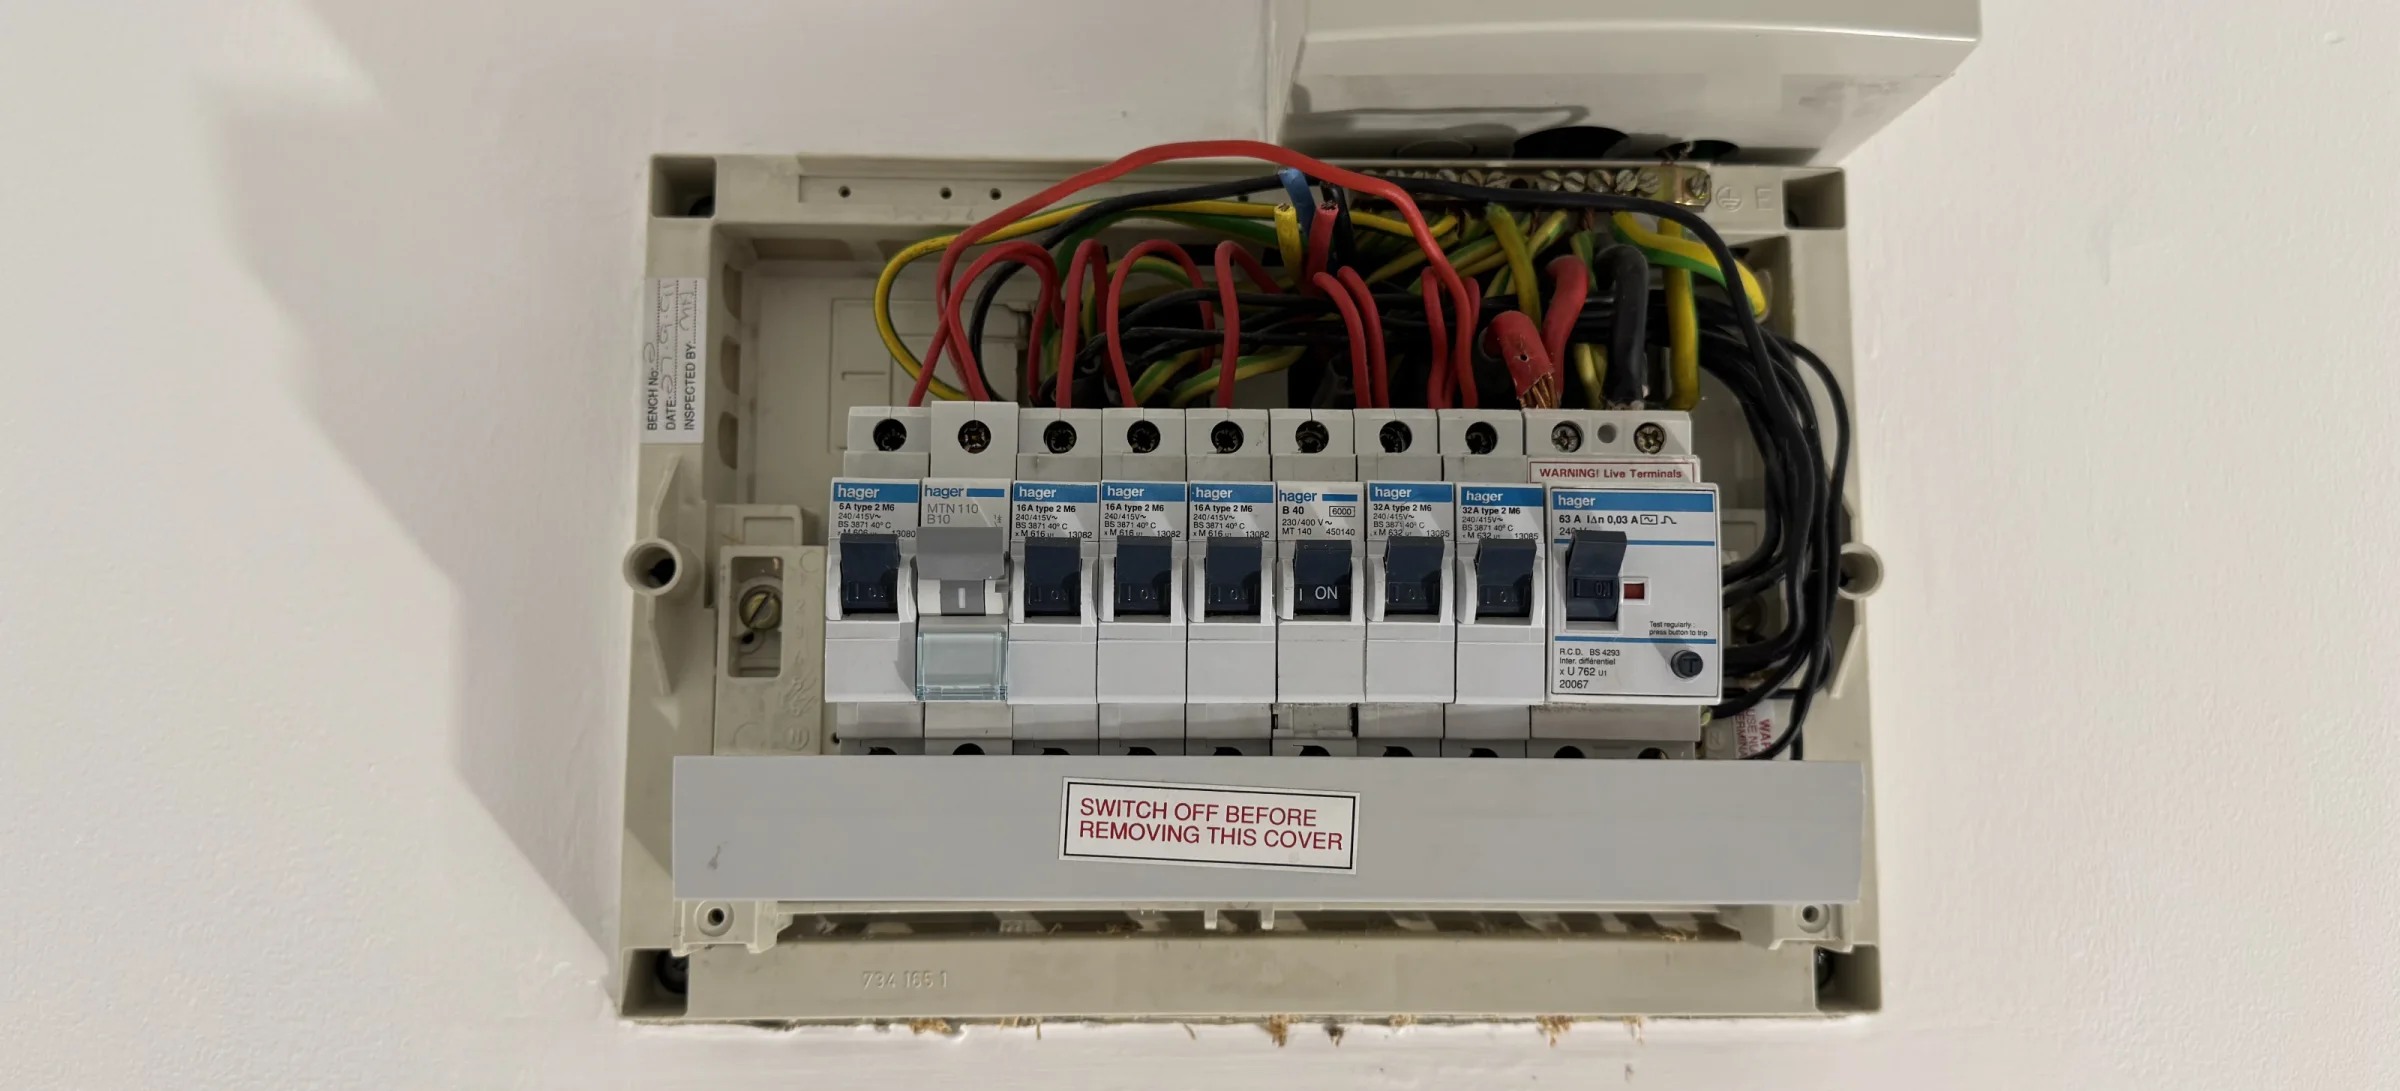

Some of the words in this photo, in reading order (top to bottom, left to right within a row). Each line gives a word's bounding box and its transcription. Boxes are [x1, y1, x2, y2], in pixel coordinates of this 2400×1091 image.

[1755, 186, 1773, 211] E
[684, 362, 696, 430] INSPECTED
[647, 391, 659, 430] BENCH
[1540, 468, 1599, 478] WARNING!
[1604, 469, 1626, 479] Live
[1630, 469, 1682, 479] Terminals
[838, 484, 880, 500] hager
[924, 484, 964, 499] hager
[1020, 486, 1057, 500] hager
[1107, 485, 1145, 500] hager
[1196, 487, 1233, 500] hager
[1375, 486, 1412, 500] hager
[1279, 490, 1317, 504] hager
[1466, 490, 1504, 504] hager
[1558, 495, 1596, 508] hager
[854, 504, 872, 512] type
[927, 504, 955, 514] MTN
[958, 504, 979, 514] 110
[1036, 505, 1054, 514] type
[1063, 505, 1076, 513] M6
[1124, 504, 1143, 512] type
[1152, 504, 1164, 512] M6
[1213, 505, 1231, 513] type
[1282, 506, 1289, 514] B
[1293, 506, 1304, 515] 40
[1392, 504, 1410, 512] type
[1420, 504, 1432, 512] M6
[1481, 507, 1499, 515] type
[1508, 507, 1521, 515] M6
[927, 514, 951, 524] B10
[1559, 515, 1571, 524] 63
[1574, 515, 1581, 524] A
[1631, 516, 1638, 524] A
[1016, 521, 1027, 529] BS
[1193, 521, 1204, 529] BS
[1326, 528, 1355, 536] 450140
[1315, 586, 1338, 600] ON
[1589, 648, 1601, 656] BS
[1602, 649, 1620, 657] 4293
[1568, 667, 1575, 676] U
[1577, 667, 1596, 676] 762
[1559, 680, 1589, 689] 20067
[1080, 798, 1168, 820] SWITCH
[1174, 802, 1220, 822] OFF
[1225, 805, 1317, 827] BEFORE
[1079, 820, 1200, 845] REMOVING
[1206, 826, 1257, 847] THIS
[1264, 830, 1343, 851] COVER
